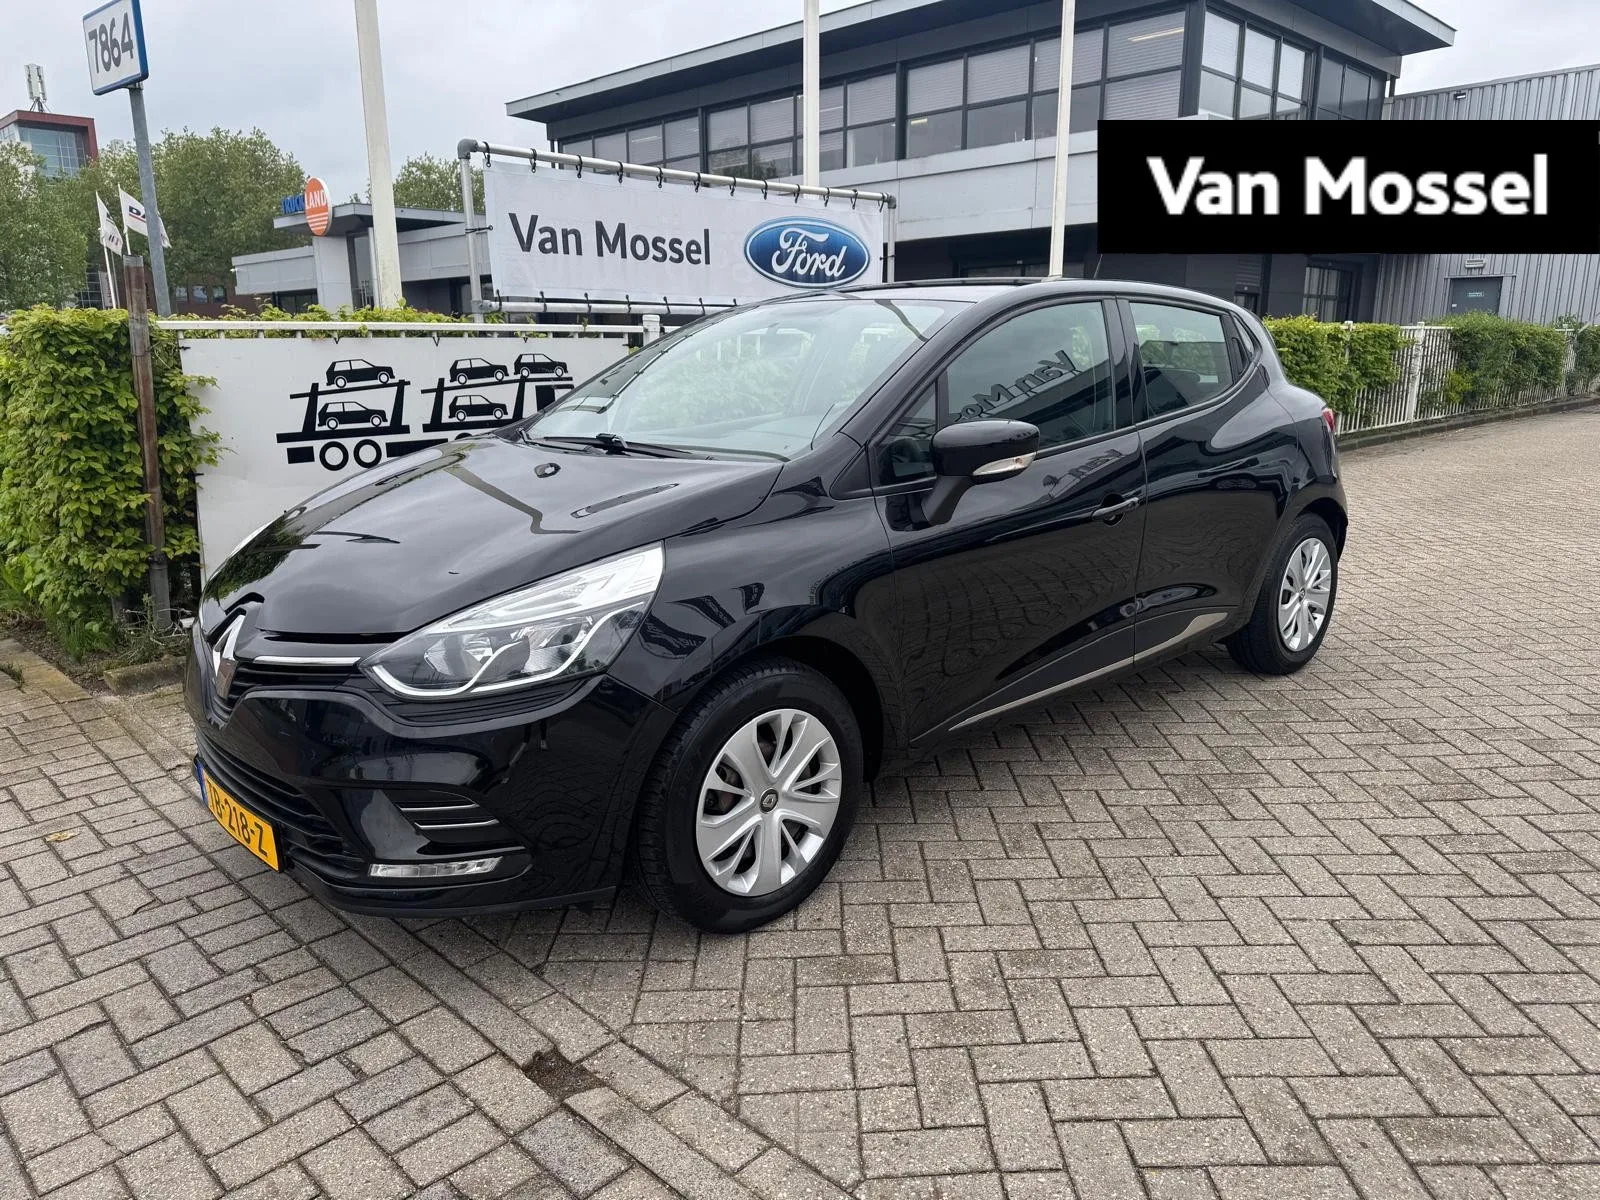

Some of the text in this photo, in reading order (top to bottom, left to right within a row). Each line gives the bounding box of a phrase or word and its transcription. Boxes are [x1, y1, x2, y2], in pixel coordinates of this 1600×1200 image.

[88, 12, 135, 74] 7864
[508, 212, 848, 278] Van Mossel Ford
